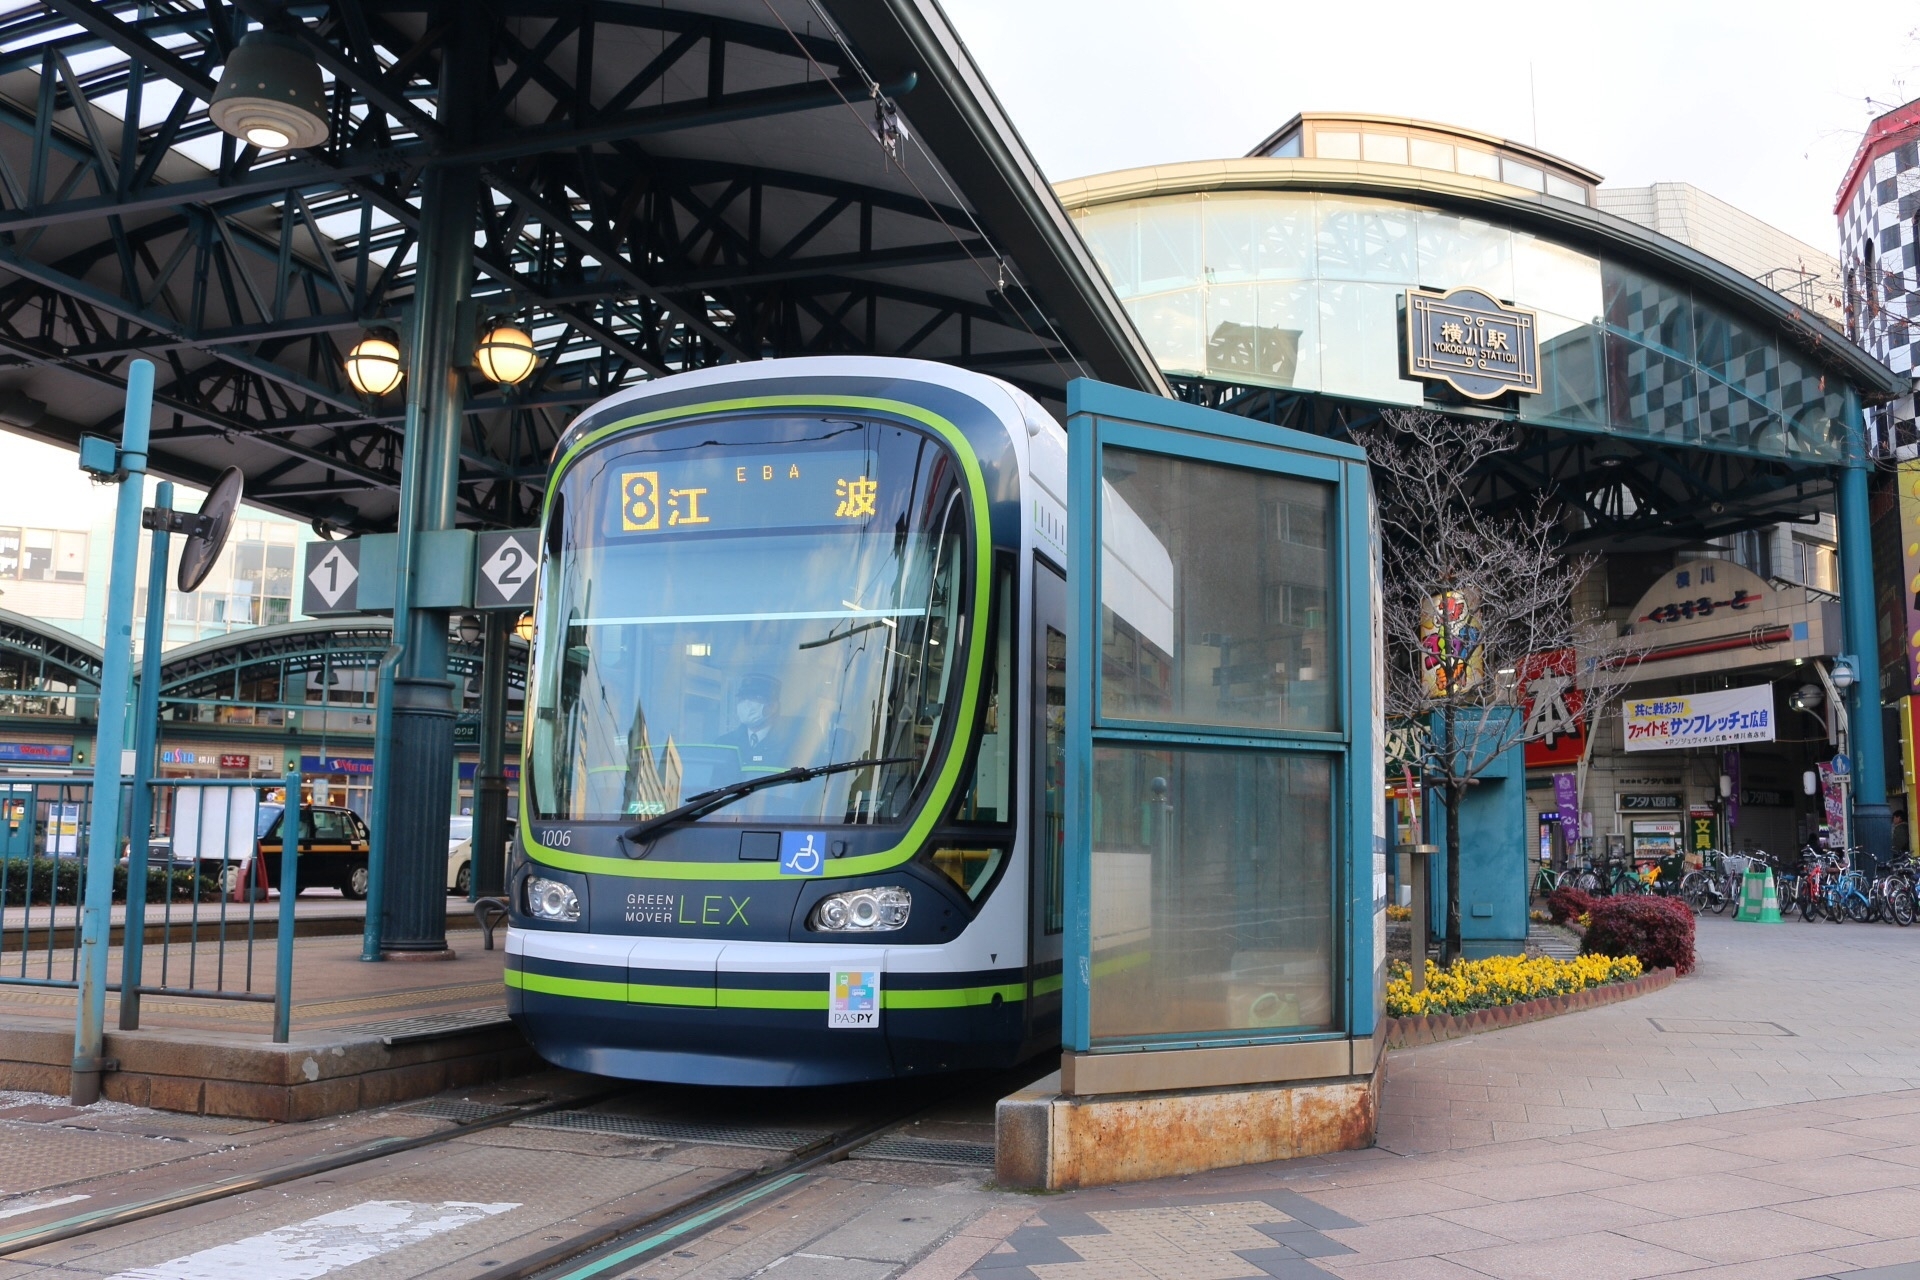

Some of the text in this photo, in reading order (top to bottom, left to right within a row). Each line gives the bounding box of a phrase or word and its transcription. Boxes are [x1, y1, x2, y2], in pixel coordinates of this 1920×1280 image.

[1441, 321, 1510, 350] 横川駅
[1434, 341, 1517, 364] YOKOGAWA STATION
[623, 475, 657, 527] 8
[667, 475, 878, 526] 江 波
[324, 556, 339, 592] 1
[498, 546, 523, 585] 2
[1522, 666, 1577, 745] 本
[630, 803, 666, 815] ワンマン
[541, 830, 572, 847] 1006
[1695, 818, 1711, 849] 文具
[625, 911, 673, 923] MOVER
[627, 894, 751, 926] GREEN LEX
[834, 1013, 873, 1024] PASPY
